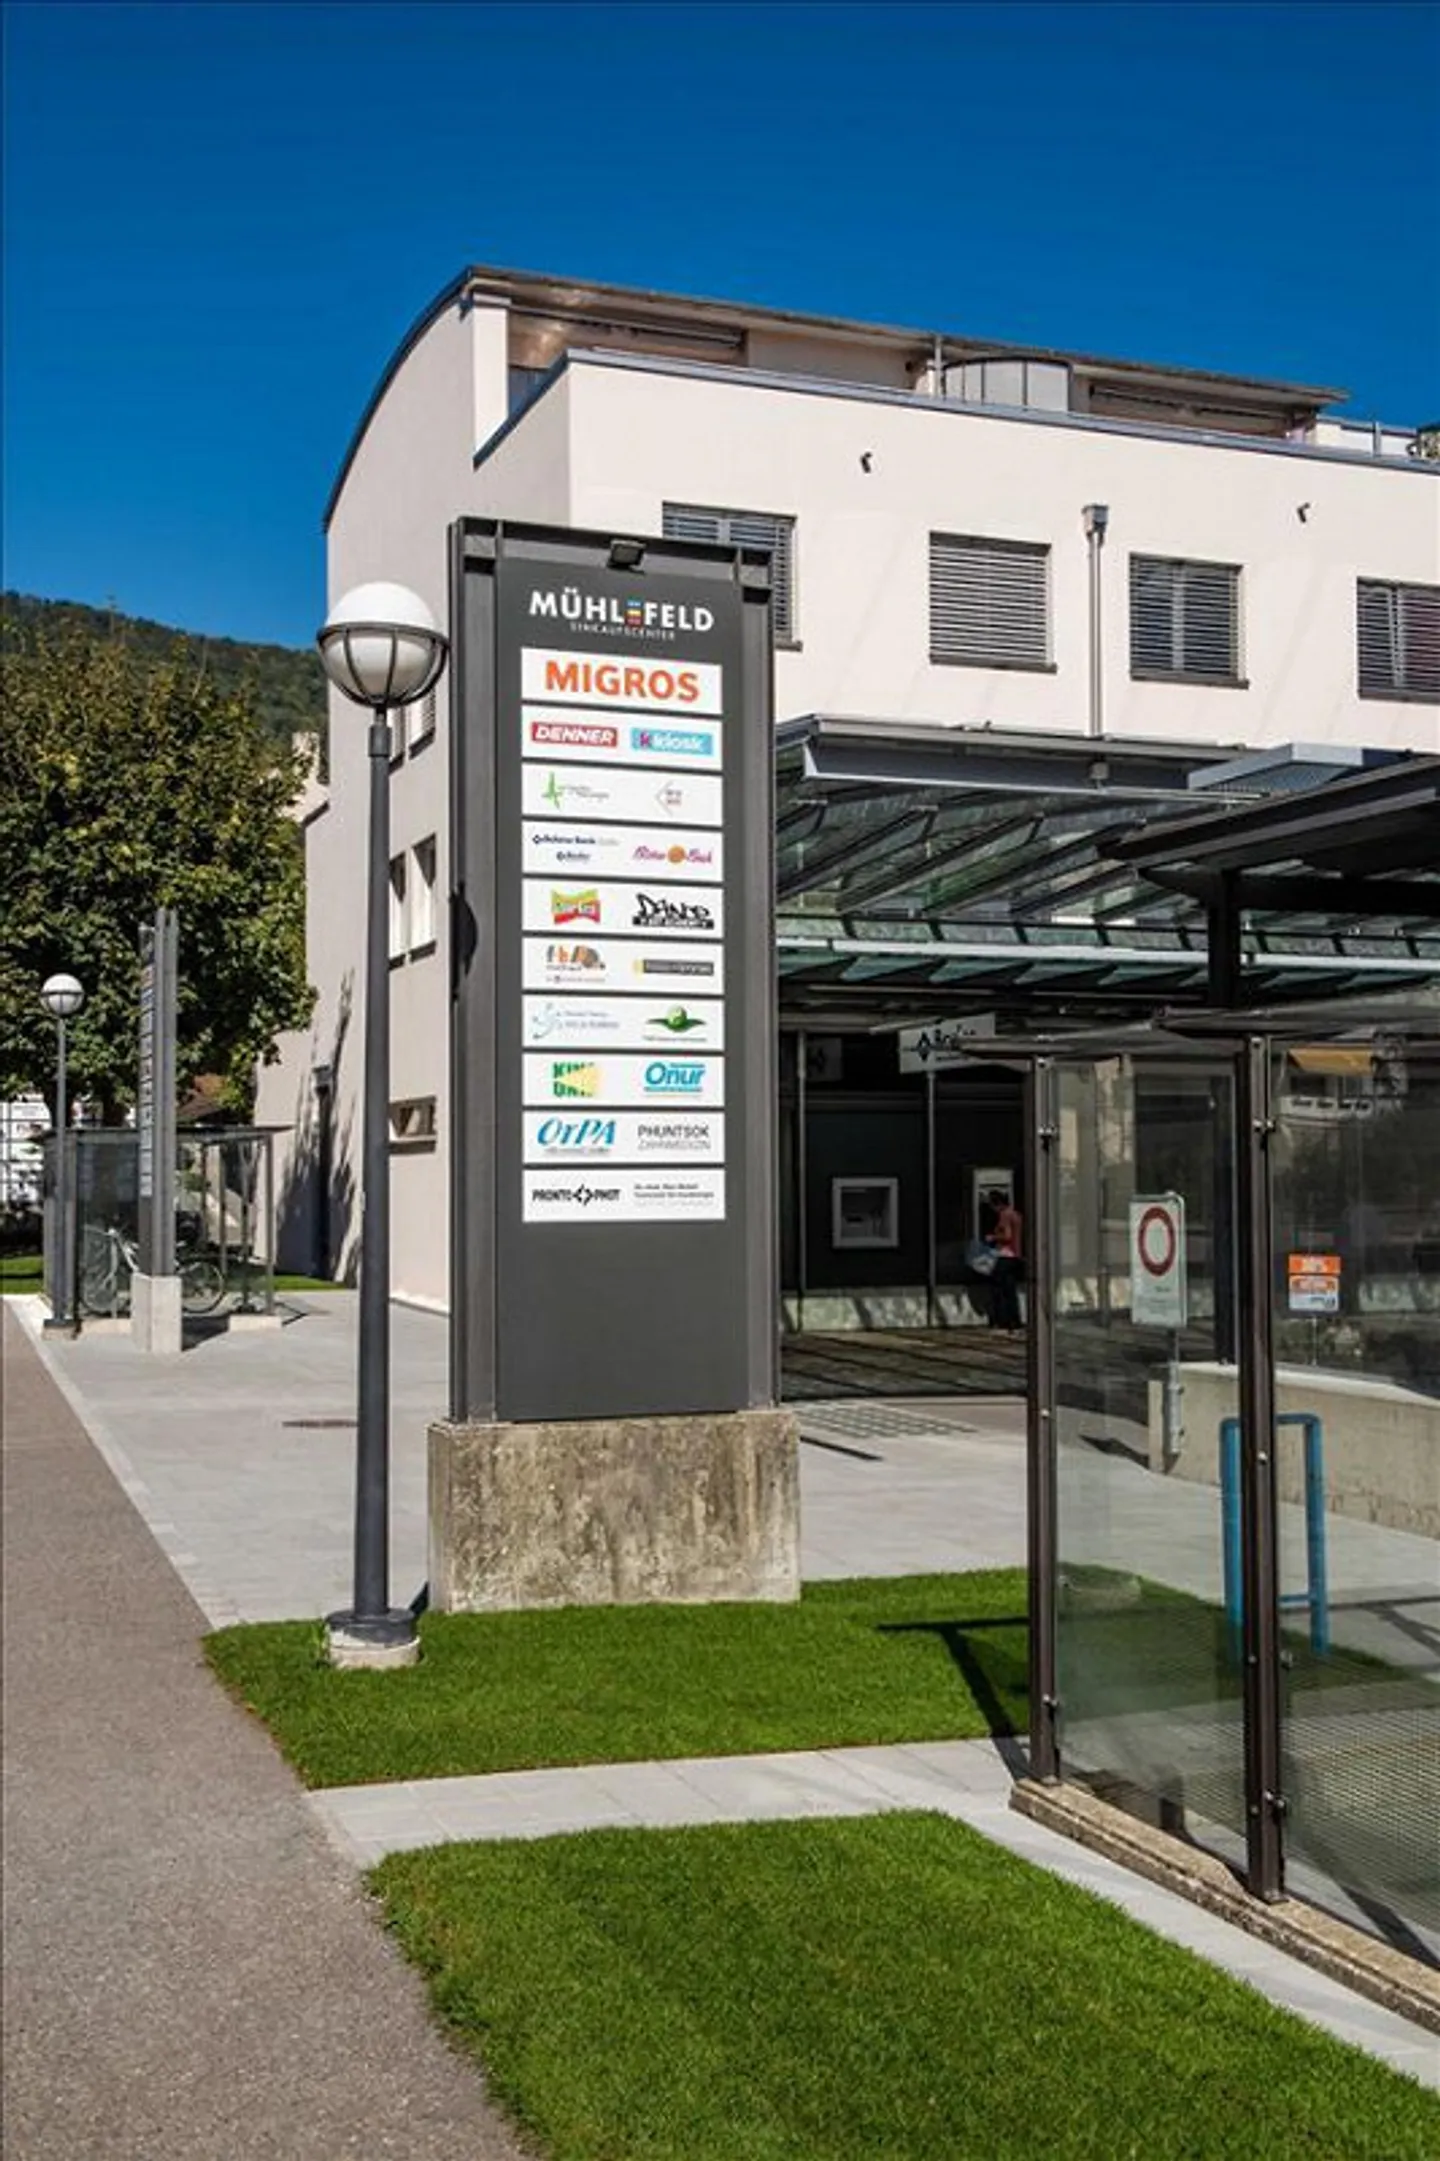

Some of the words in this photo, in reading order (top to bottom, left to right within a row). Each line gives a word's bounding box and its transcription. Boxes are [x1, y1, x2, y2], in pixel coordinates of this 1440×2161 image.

[545, 659, 700, 704] MIGROS
[534, 722, 616, 746] DENNER
[644, 1061, 706, 1085] Onur
[537, 1116, 617, 1147] OrPA
